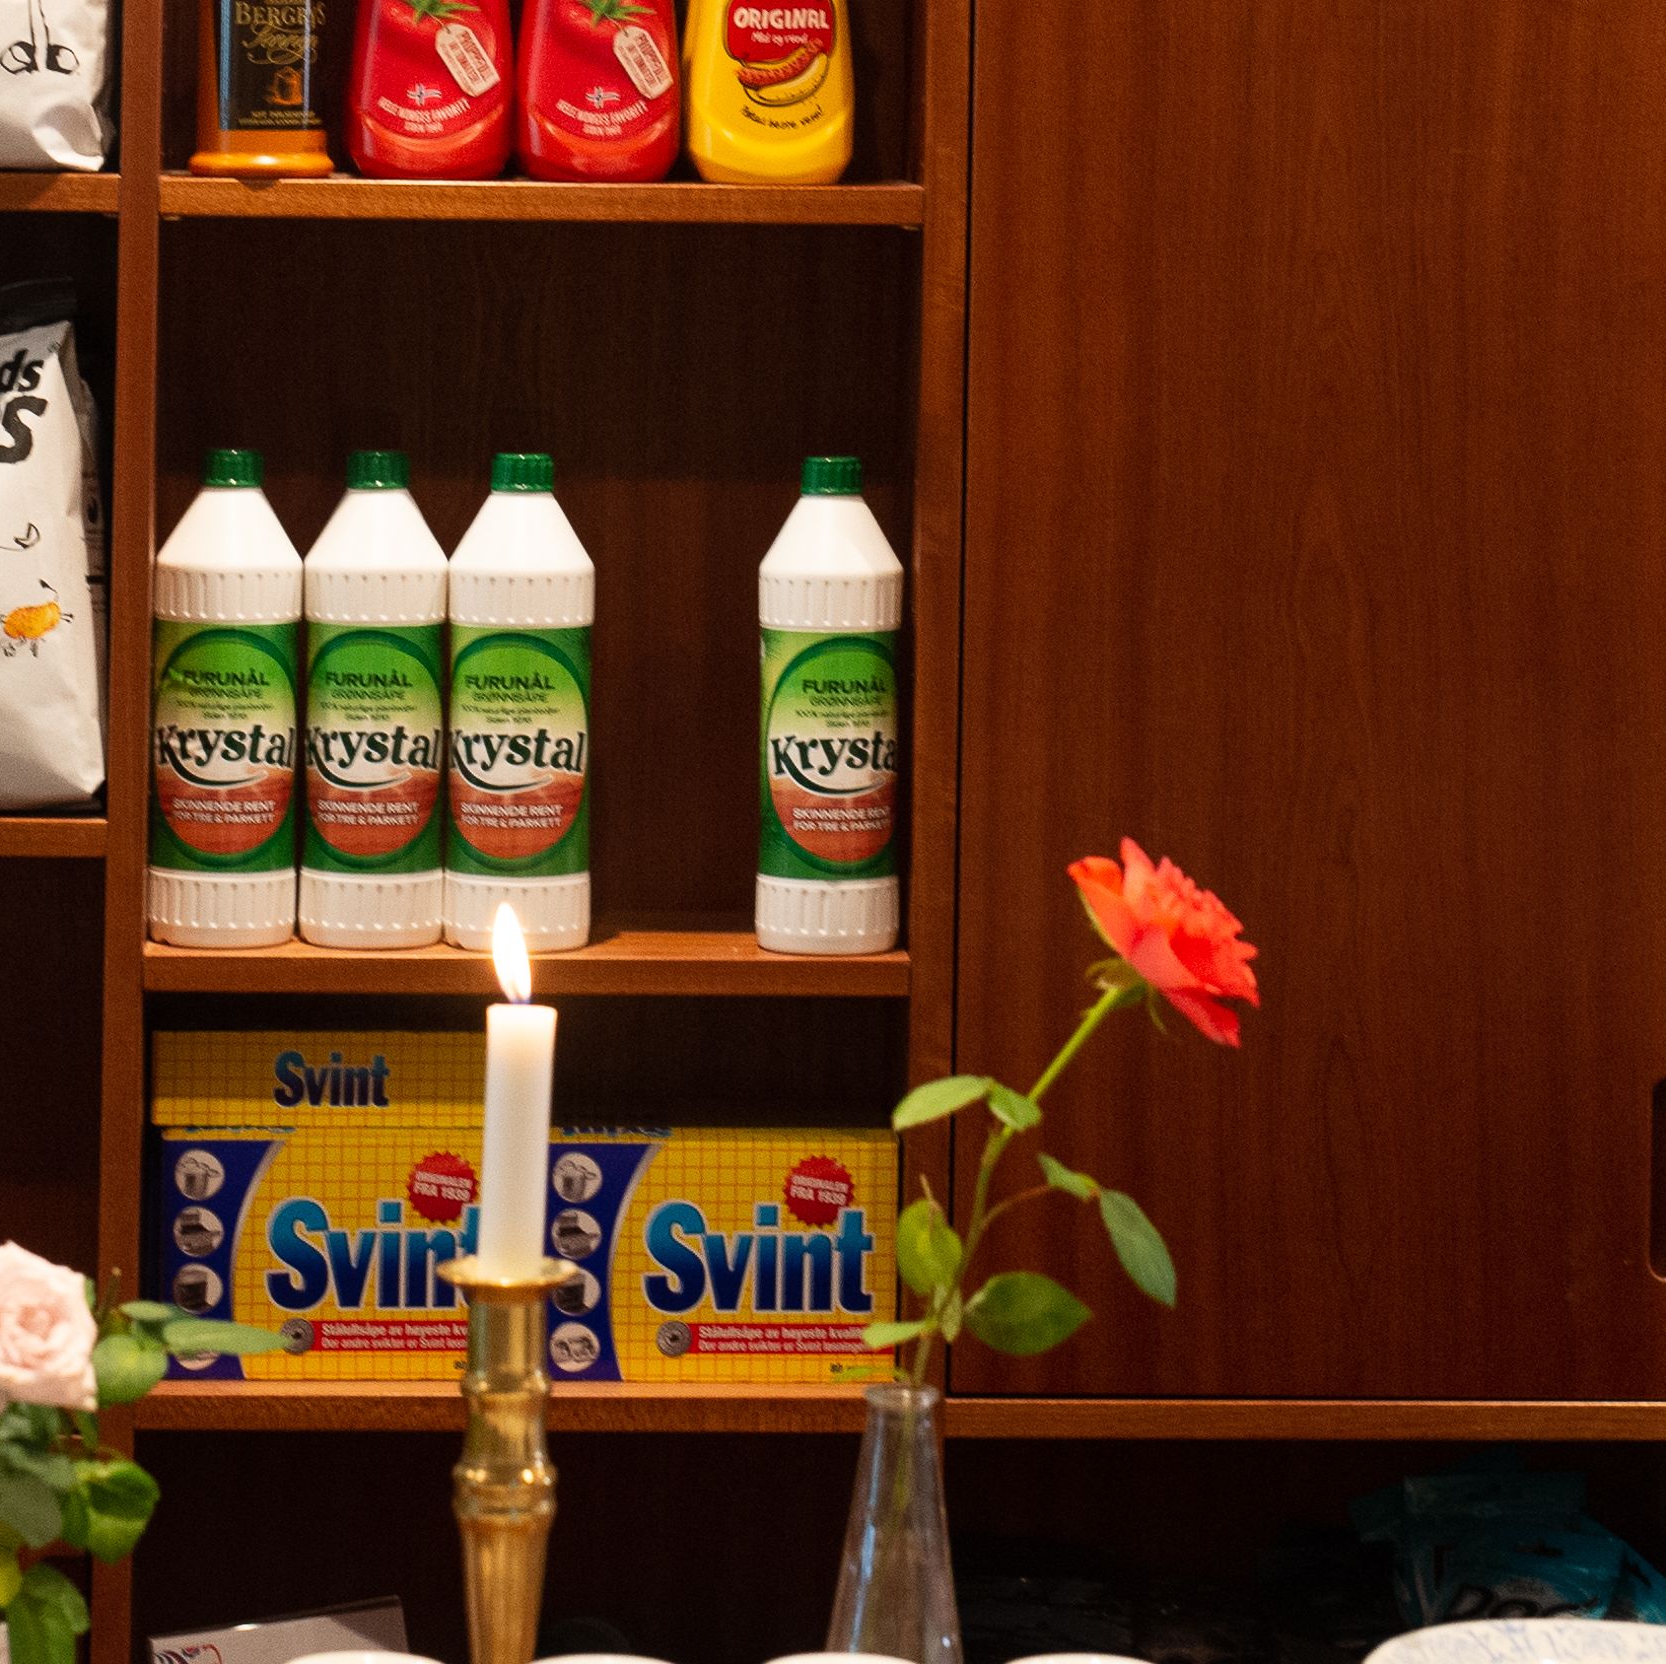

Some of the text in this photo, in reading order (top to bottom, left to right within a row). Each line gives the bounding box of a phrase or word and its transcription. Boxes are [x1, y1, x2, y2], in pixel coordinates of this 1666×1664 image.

[733, 7, 830, 31] ORIGINAL
[182, 669, 270, 688] FURUNÅL
[325, 669, 413, 688] FURUNÅL
[465, 673, 555, 691] FURUNÅL
[159, 724, 295, 769] Krystal
[306, 725, 441, 770] Krystal
[770, 731, 897, 777] Krysta
[273, 1050, 390, 1107] Svint
[642, 1199, 875, 1314] Svint
